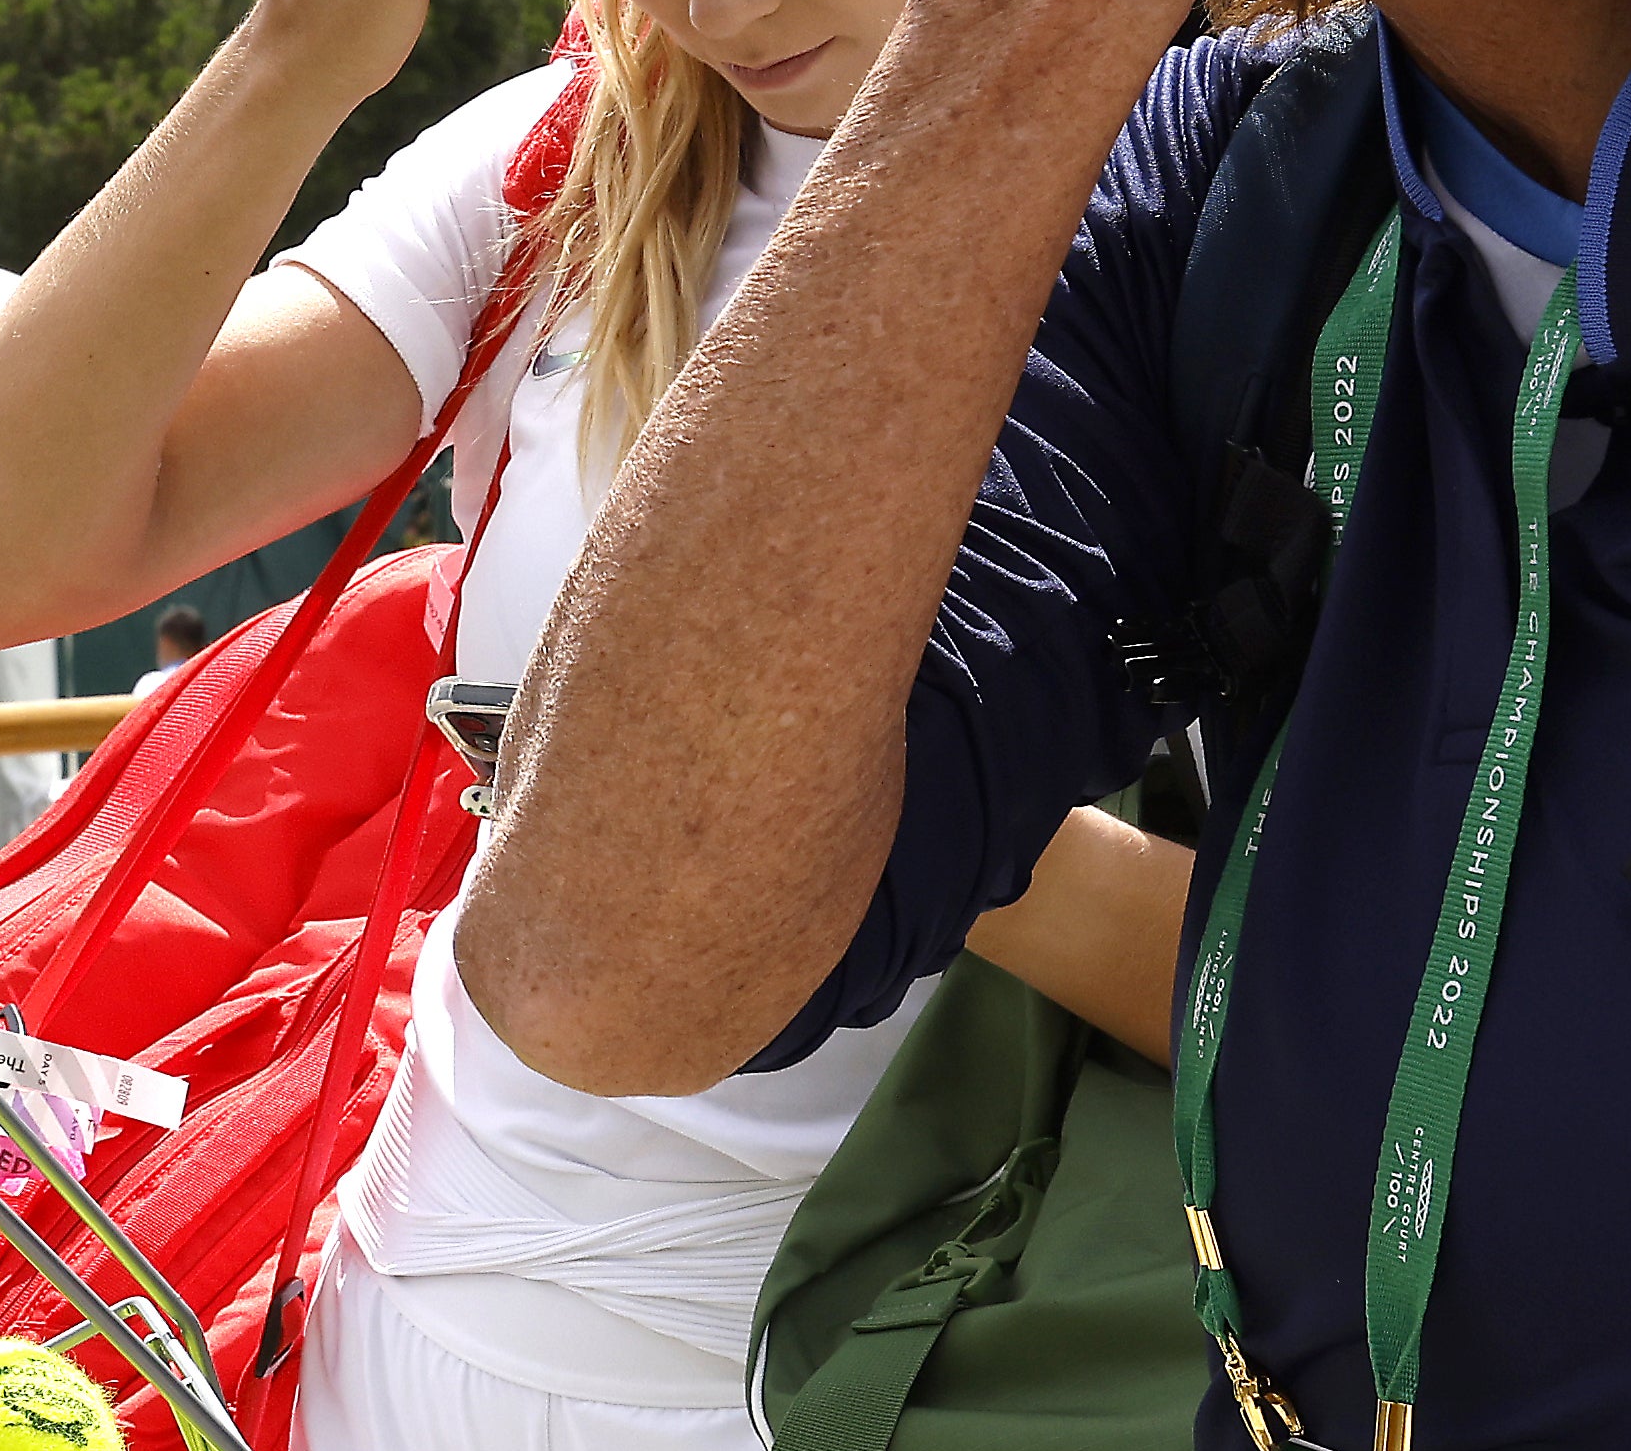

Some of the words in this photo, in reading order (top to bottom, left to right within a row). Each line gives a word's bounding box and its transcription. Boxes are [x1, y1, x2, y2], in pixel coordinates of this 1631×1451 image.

[1334, 354, 1358, 447] 2022
[1528, 519, 1540, 592] THE
[1457, 610, 1540, 940] CHAMPIONSHIPS
[1426, 955, 1471, 1050] 2022
[38, 1077, 47, 1087] 5
[39, 1052, 54, 1078] DAY
[1405, 1126, 1425, 1197] CENTRE
[1397, 1202, 1413, 1264] COURT
